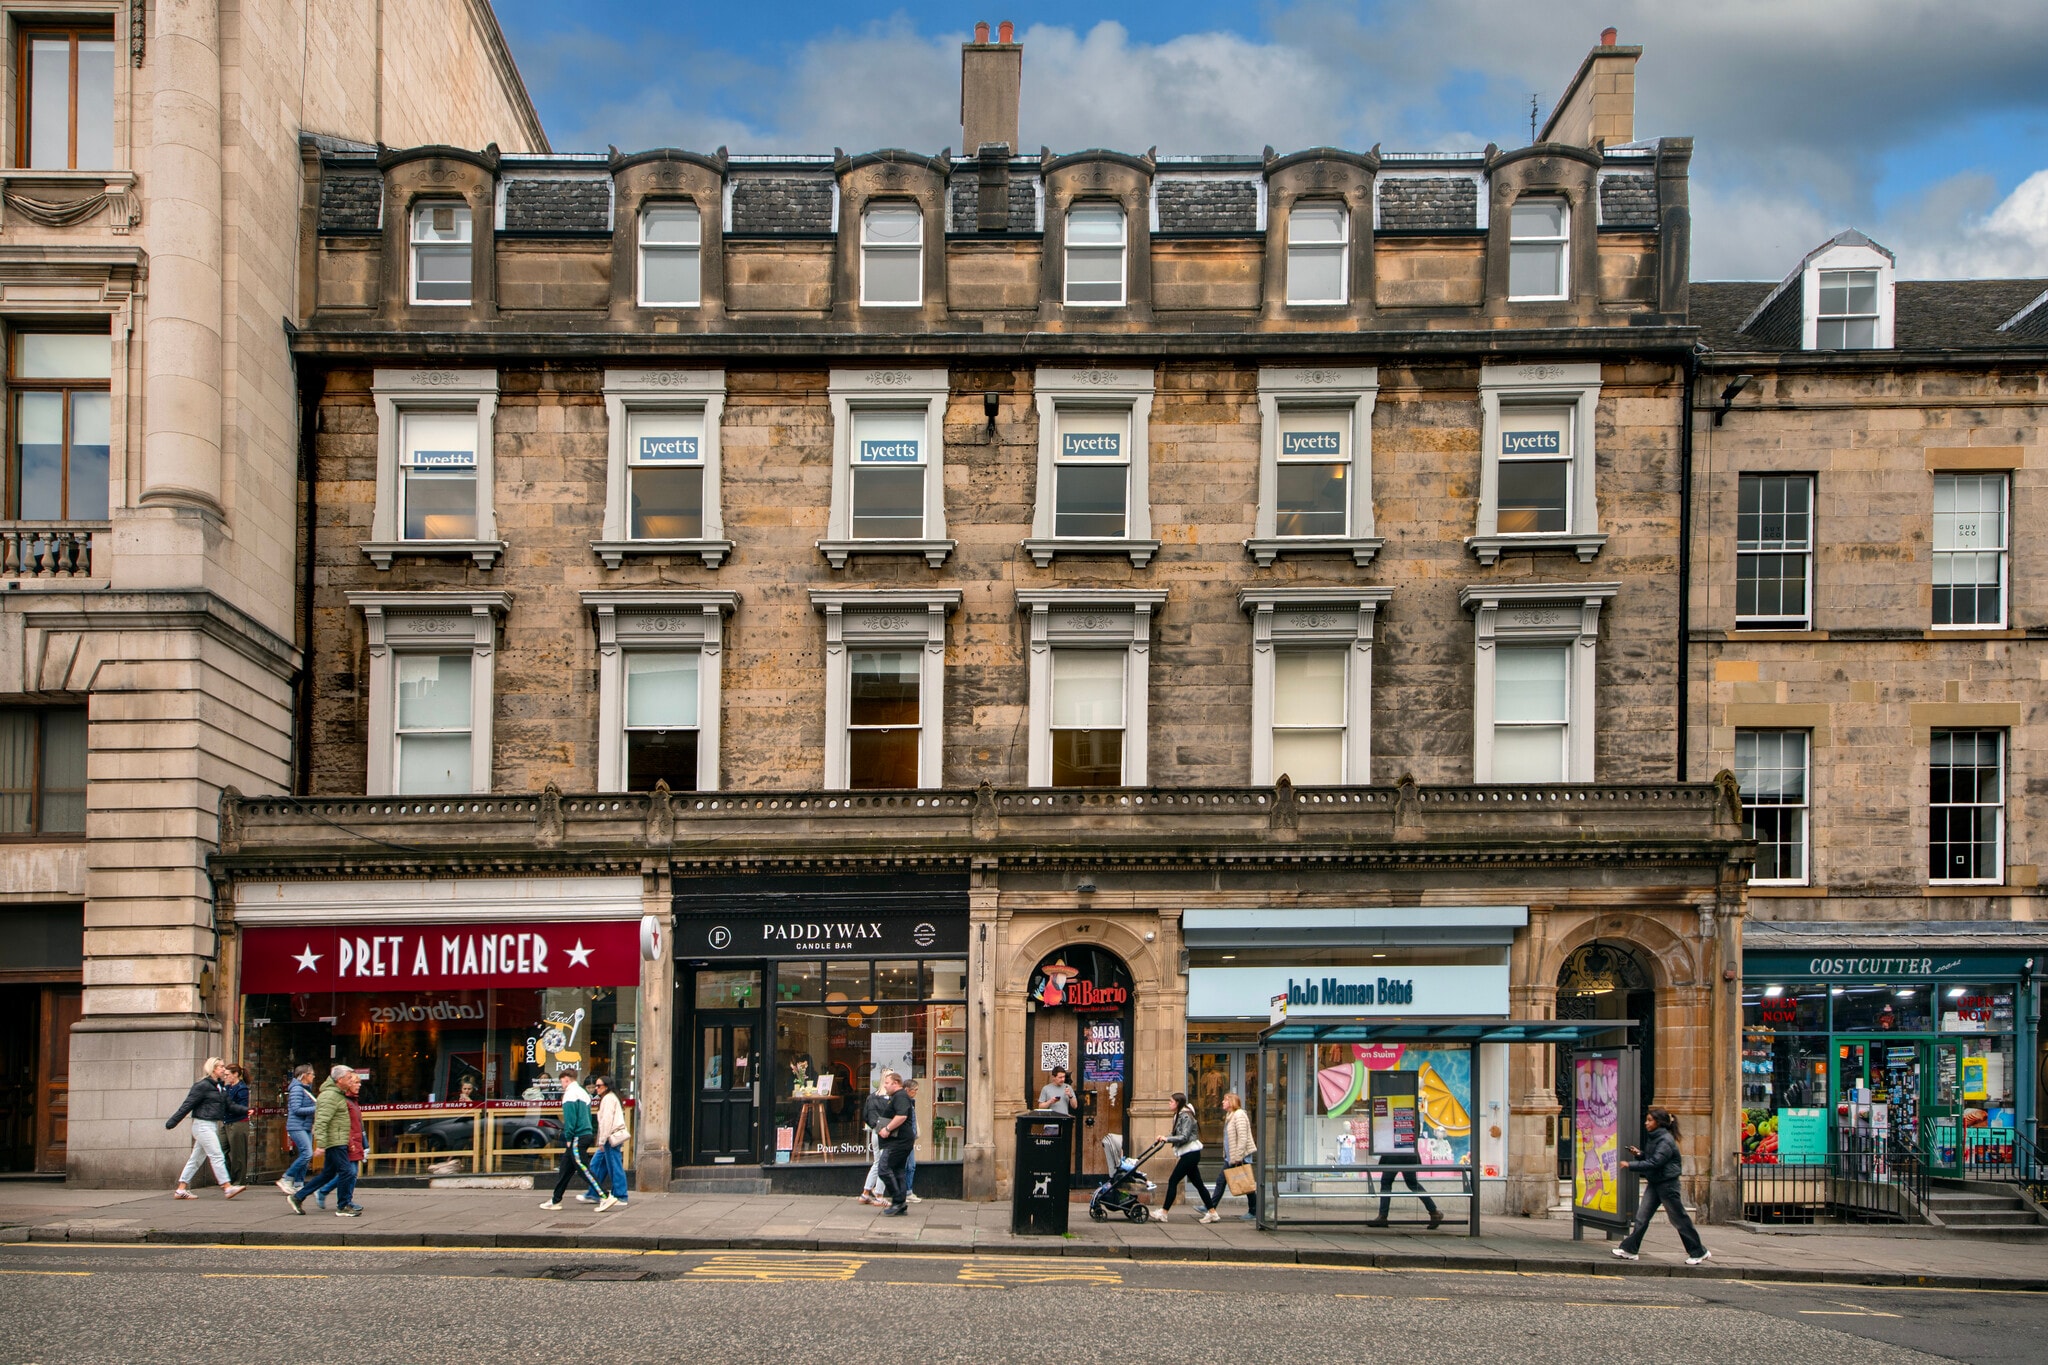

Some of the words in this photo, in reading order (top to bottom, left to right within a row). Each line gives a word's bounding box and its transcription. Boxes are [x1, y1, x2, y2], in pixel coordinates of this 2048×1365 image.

[643, 439, 696, 457] Lycetts
[1066, 435, 1117, 453] Lycetts
[1286, 434, 1337, 452] Lycetts
[1505, 433, 1557, 452] Lycetts
[864, 443, 916, 461] Lycetts
[763, 923, 882, 940] PADDYWAX
[796, 942, 831, 950] CANDLE
[338, 935, 404, 978] PRET
[411, 934, 430, 977] A
[440, 932, 549, 976] MANGER
[1809, 958, 1932, 975] COSTCUTTER
[1287, 978, 1319, 1005] JoJo
[1322, 978, 1375, 1005] Maman
[1378, 977, 1413, 1005] Bébé
[1760, 997, 1798, 1009] OPEN
[1957, 996, 1995, 1008] OPEN
[547, 1010, 575, 1024] Feel
[1763, 1010, 1796, 1022] NOW
[1958, 1009, 1992, 1022] NOW
[1092, 1025, 1121, 1039] SALSA
[526, 1036, 537, 1063] Good
[1086, 1041, 1124, 1055] CLASSES
[1373, 1050, 1396, 1058] Swim
[555, 1061, 582, 1071] Food.
[817, 1143, 839, 1154] Pour,
[841, 1142, 867, 1154] Shop,
